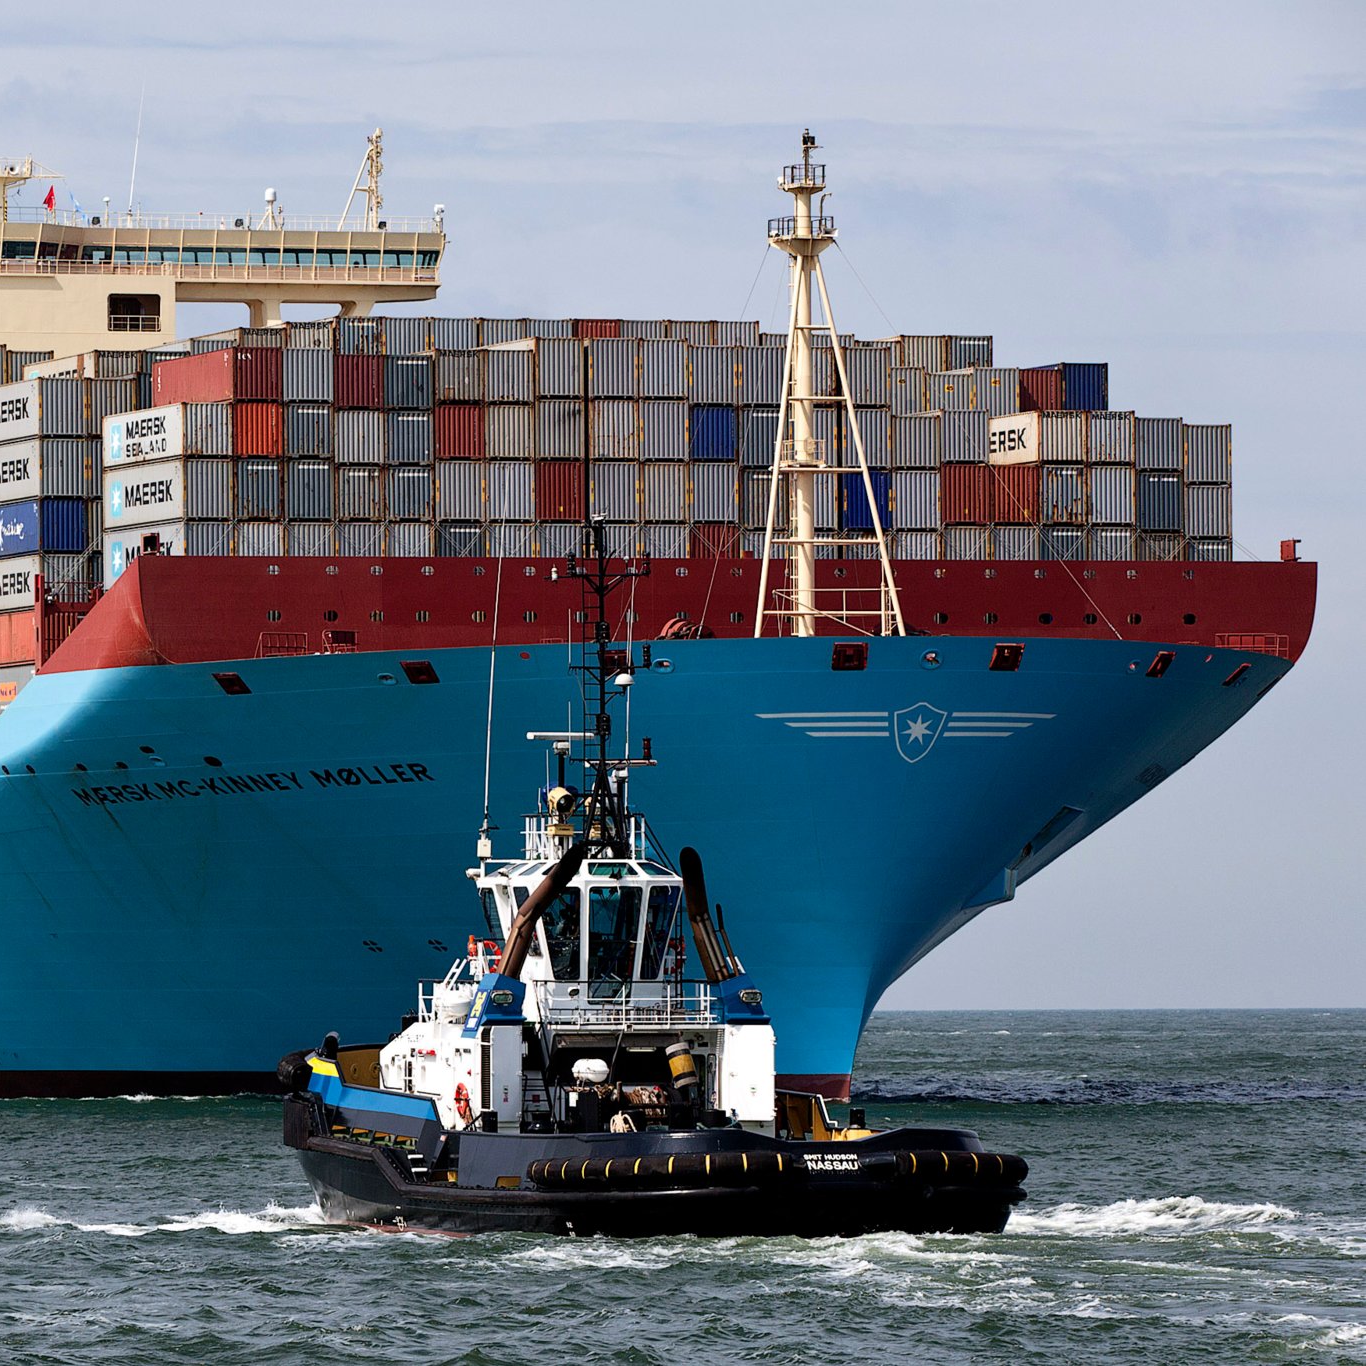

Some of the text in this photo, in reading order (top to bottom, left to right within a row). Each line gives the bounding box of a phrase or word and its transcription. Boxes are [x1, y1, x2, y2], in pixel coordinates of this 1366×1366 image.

[125, 415, 167, 439] MAERSK
[125, 438, 168, 458] SEALAND
[989, 427, 1027, 454] ERSK
[125, 479, 174, 508] MAERSK
[154, 772, 304, 800] MC-KINNEY
[310, 762, 436, 788] MØLLER
[806, 1160, 859, 1170] NASSAU
